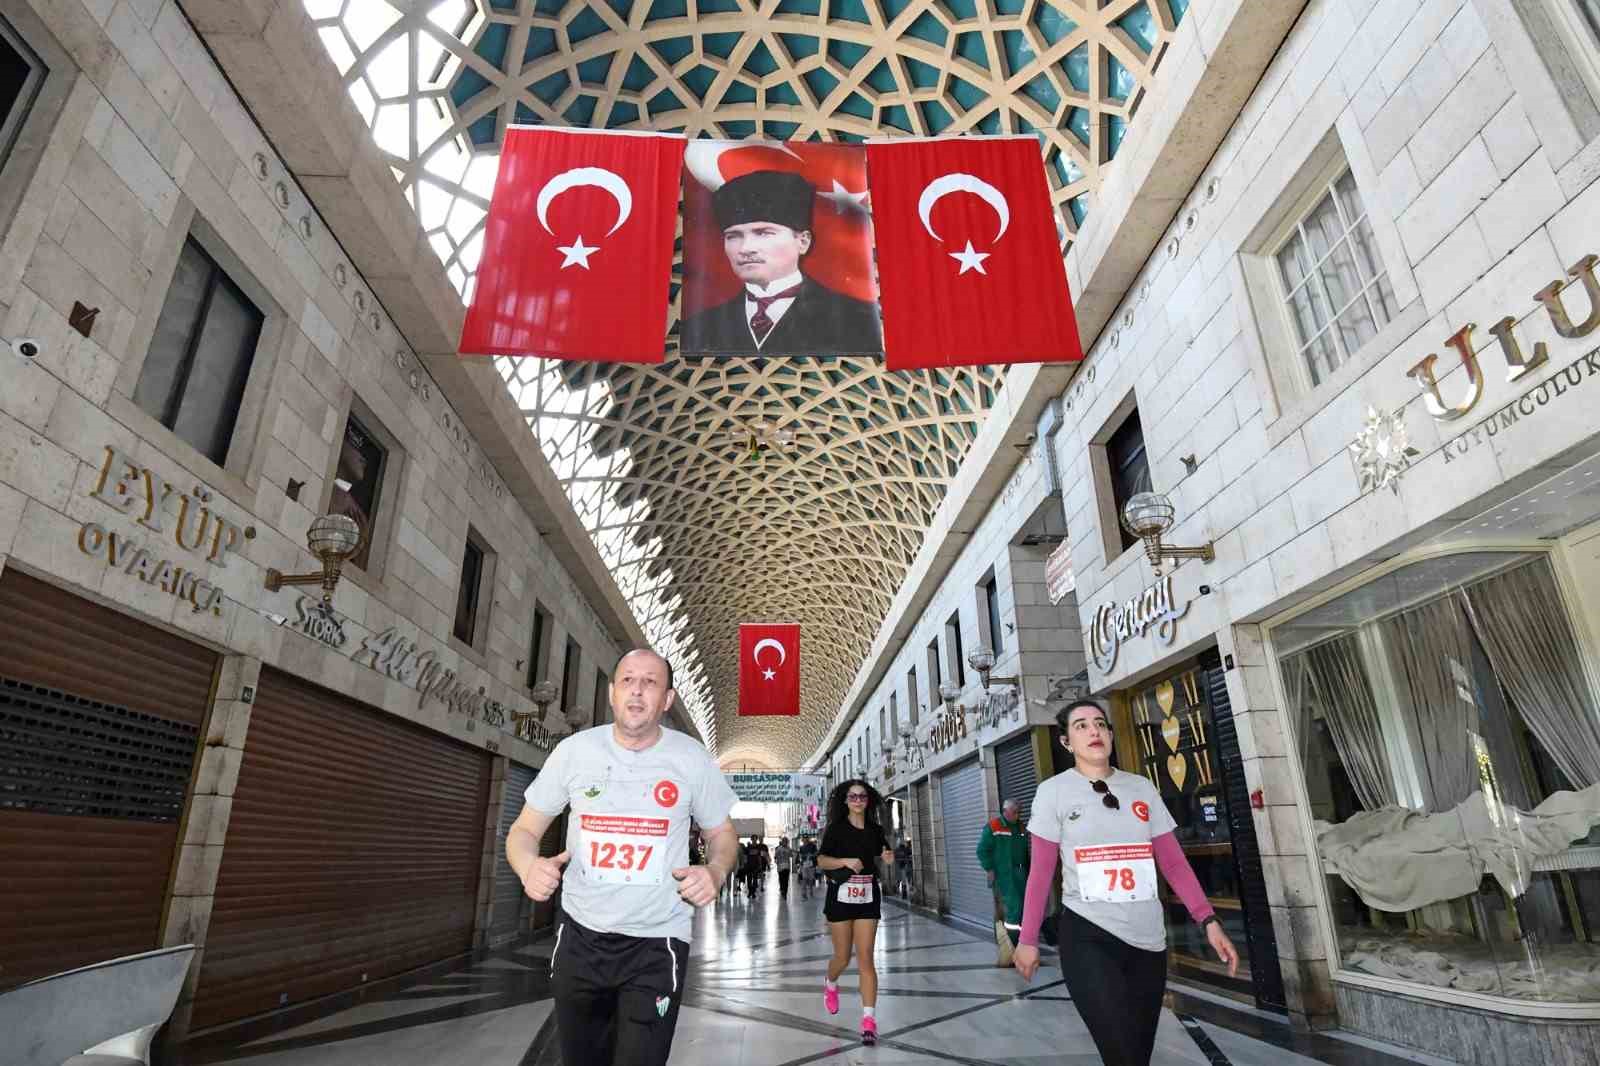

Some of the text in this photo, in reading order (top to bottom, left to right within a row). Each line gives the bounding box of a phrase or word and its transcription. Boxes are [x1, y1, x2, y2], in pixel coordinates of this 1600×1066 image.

[1406, 254, 1600, 421] ULU
[89, 445, 243, 568] EYÜP
[733, 774, 791, 783] BURSASPOR
[591, 842, 653, 871] 1237
[848, 887, 866, 898] 194
[1104, 868, 1135, 891] 78
